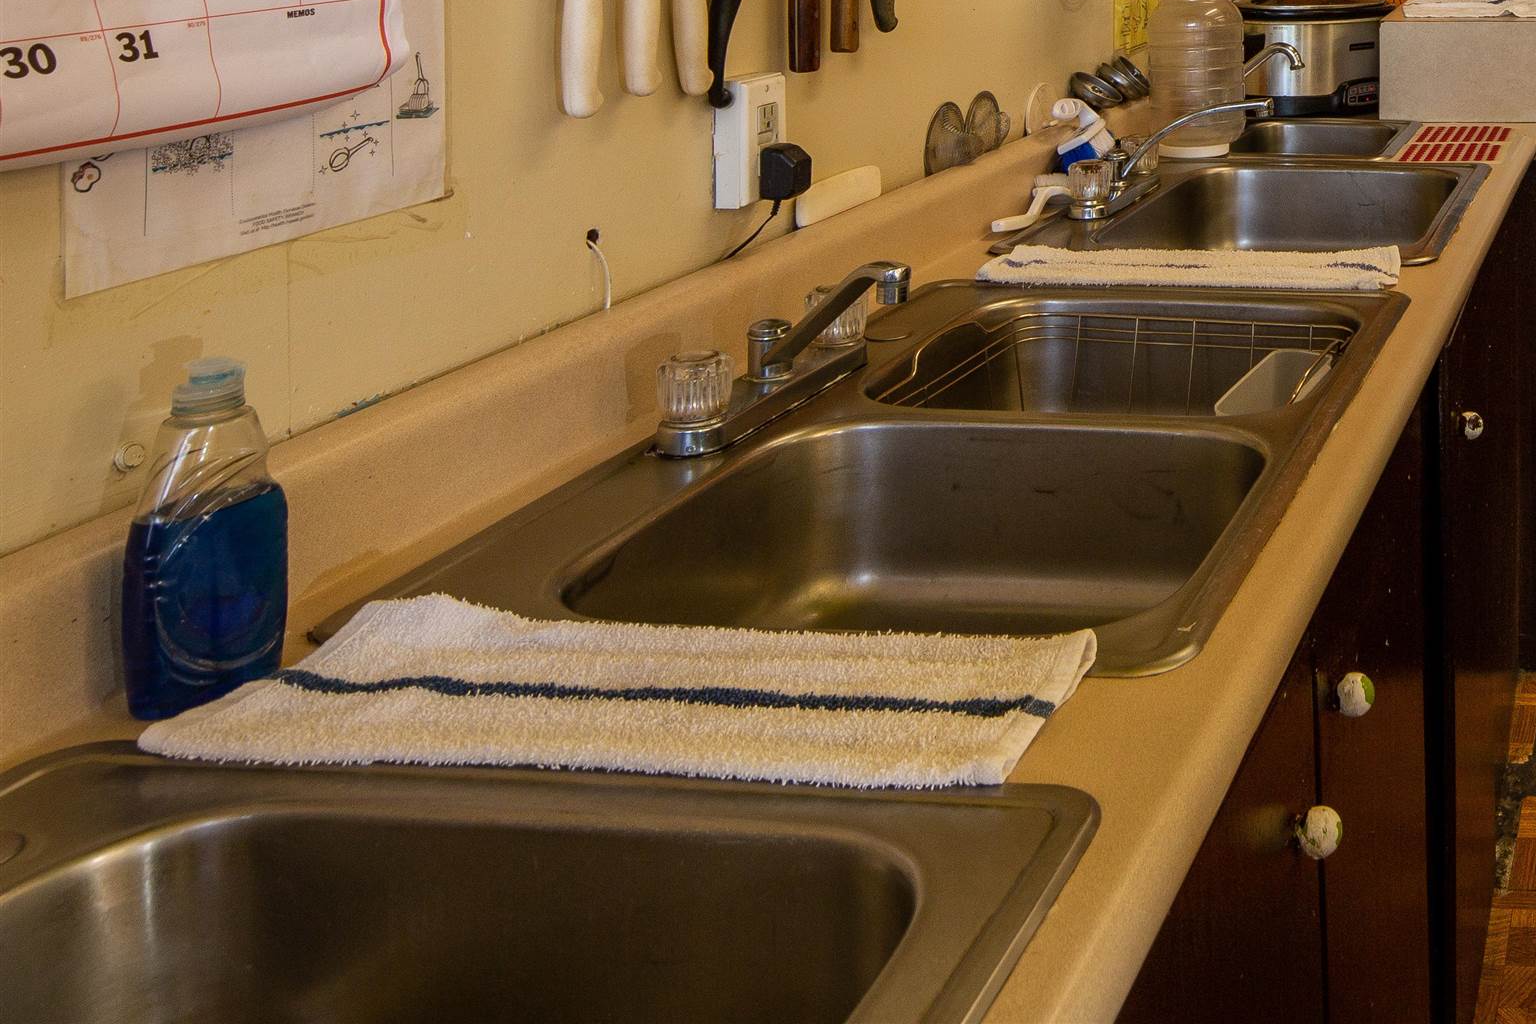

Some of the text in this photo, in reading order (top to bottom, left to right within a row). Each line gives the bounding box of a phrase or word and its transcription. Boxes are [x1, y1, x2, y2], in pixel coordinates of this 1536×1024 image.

[286, 7, 316, 19] MEMOS
[0, 42, 57, 79] 30
[115, 29, 159, 63] 31
